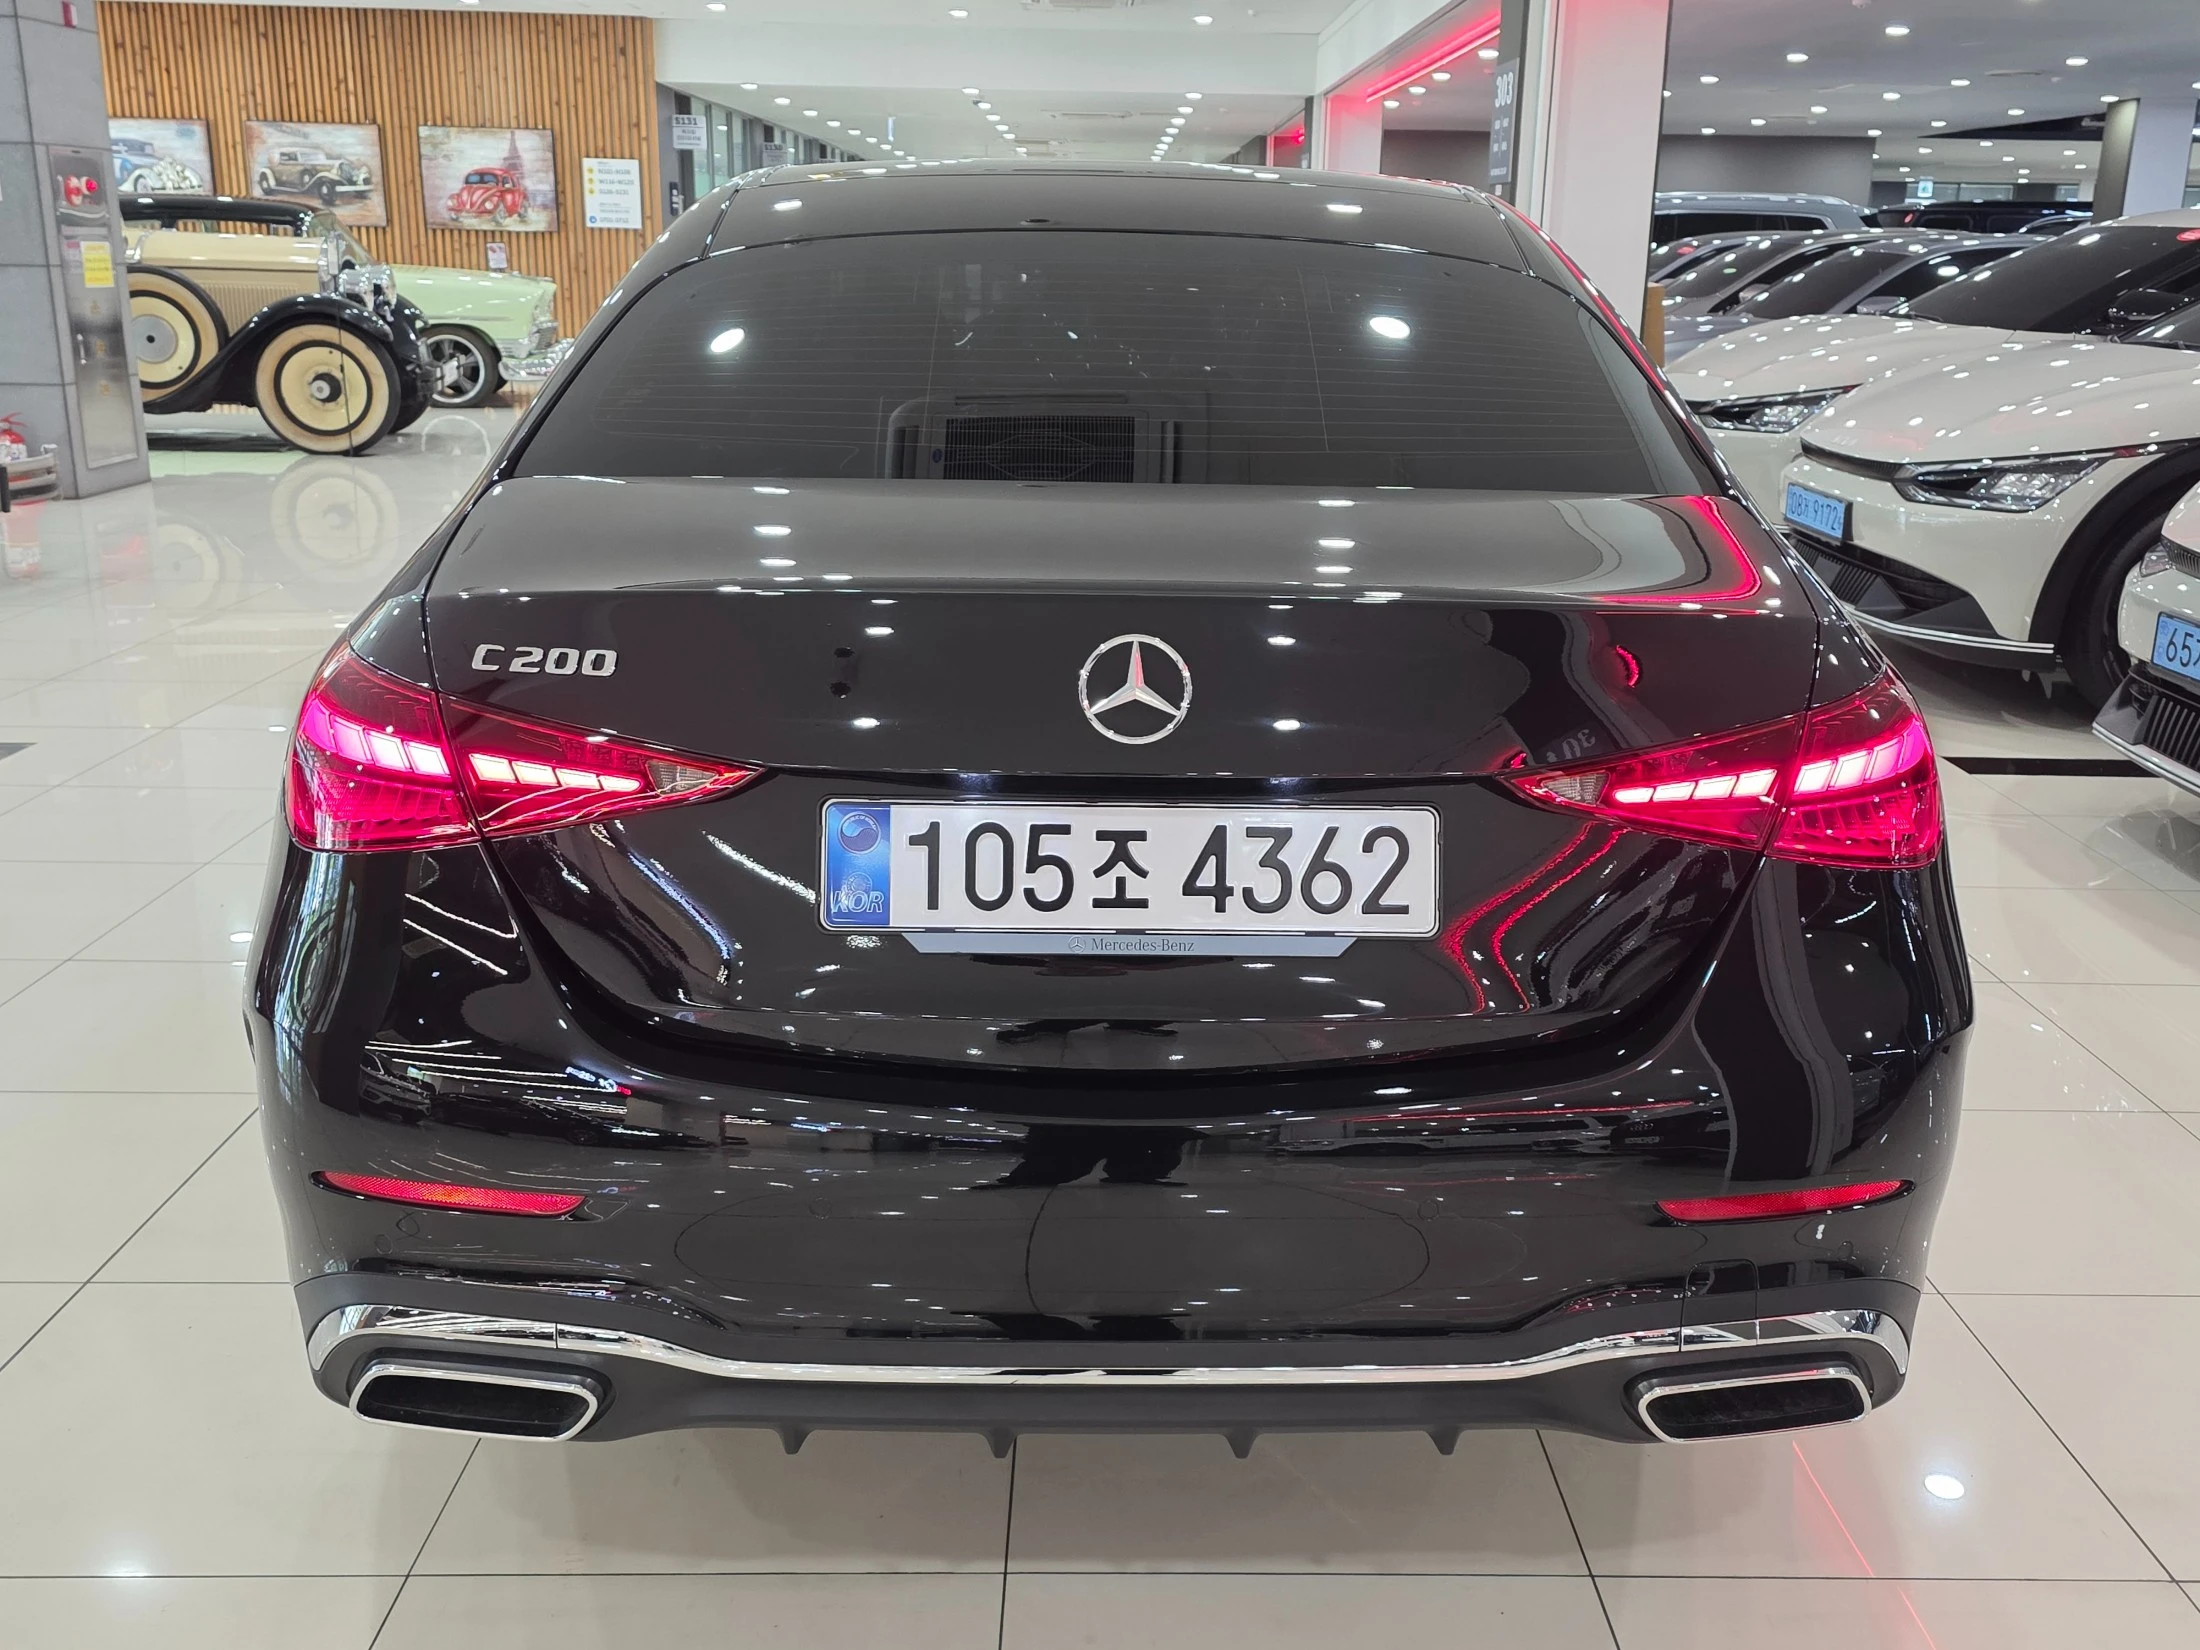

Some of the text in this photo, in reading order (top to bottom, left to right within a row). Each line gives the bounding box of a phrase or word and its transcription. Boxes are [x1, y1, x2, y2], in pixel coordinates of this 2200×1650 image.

[1495, 72, 1513, 108] 303
[675, 116, 698, 126] S131
[1813, 499, 1838, 531] 9172
[908, 820, 1410, 915] 105조 4362
[830, 890, 885, 913] KOR
[1091, 938, 1195, 952] Mercedes-Benz
